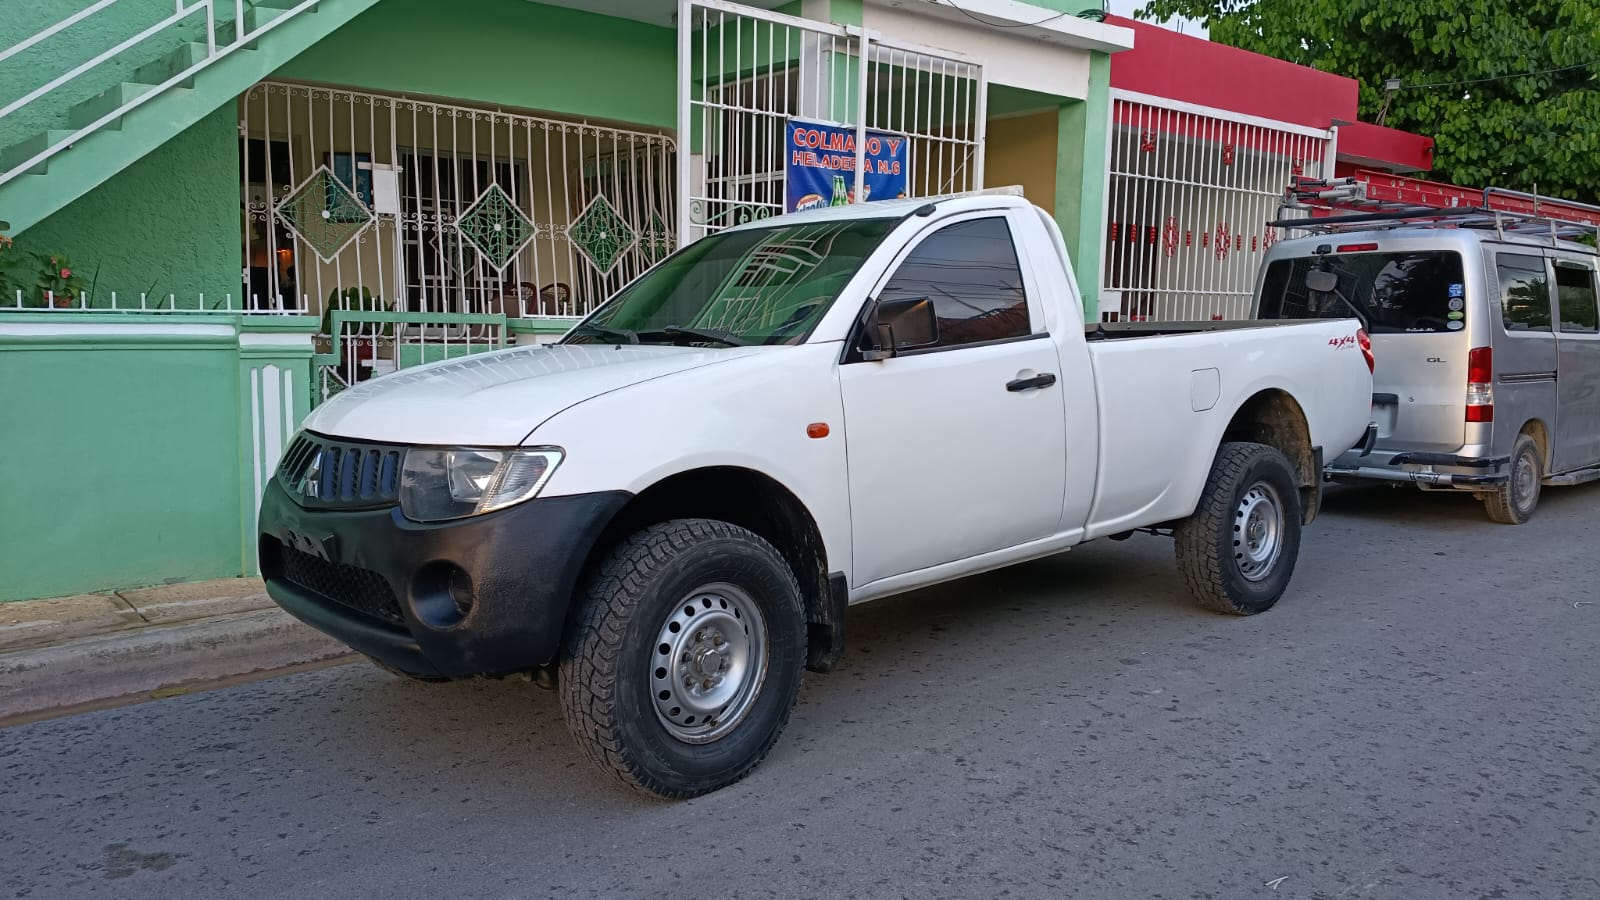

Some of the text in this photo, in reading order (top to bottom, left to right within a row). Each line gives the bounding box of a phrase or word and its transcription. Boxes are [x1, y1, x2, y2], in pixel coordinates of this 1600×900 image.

[793, 127, 900, 157] COLMAO Y
[792, 150, 873, 174] HELADERA
